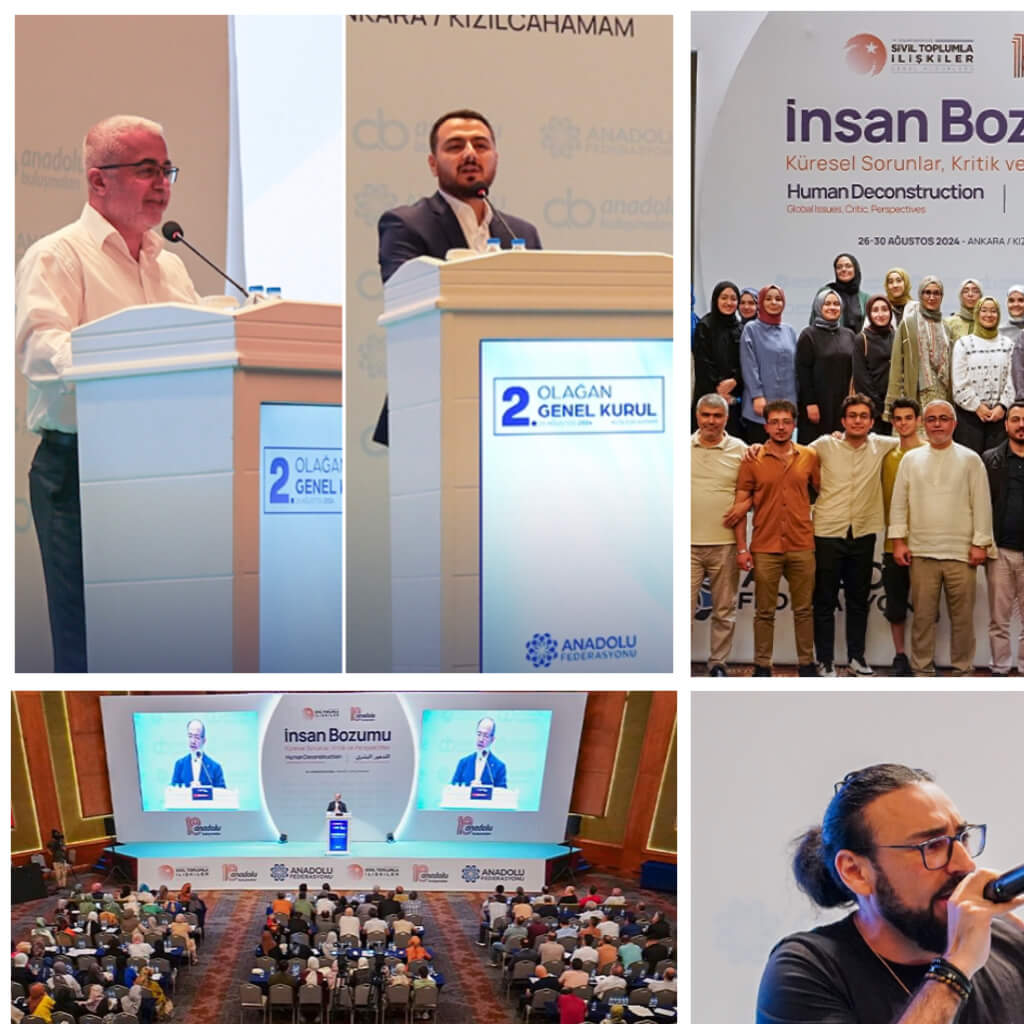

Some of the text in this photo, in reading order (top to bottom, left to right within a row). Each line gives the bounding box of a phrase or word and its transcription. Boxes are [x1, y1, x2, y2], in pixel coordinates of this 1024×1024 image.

[918, 44, 973, 53] TOPLUMLA
[786, 99, 928, 143] İnsan
[785, 154, 856, 172] Küresel
[861, 155, 945, 174] Sorunlar,
[952, 155, 1000, 172] Kritik
[787, 184, 984, 200] Human Deconstruction
[858, 236, 886, 246] 26-30
[888, 234, 934, 246] AĞUSTOS
[936, 236, 960, 246] 2024
[967, 236, 1005, 246] ANKARA
[537, 384, 612, 400] OLAĞAN
[501, 386, 537, 427] 2.
[537, 403, 657, 418] GENEL KURUL
[295, 479, 336, 494] GENEL
[561, 635, 637, 651] ANADOLU
[561, 650, 637, 662] FEDERASYONU
[328, 727, 392, 742] Bozumu
[290, 866, 333, 875] ANADOLU
[482, 868, 525, 876] ANADOLU
